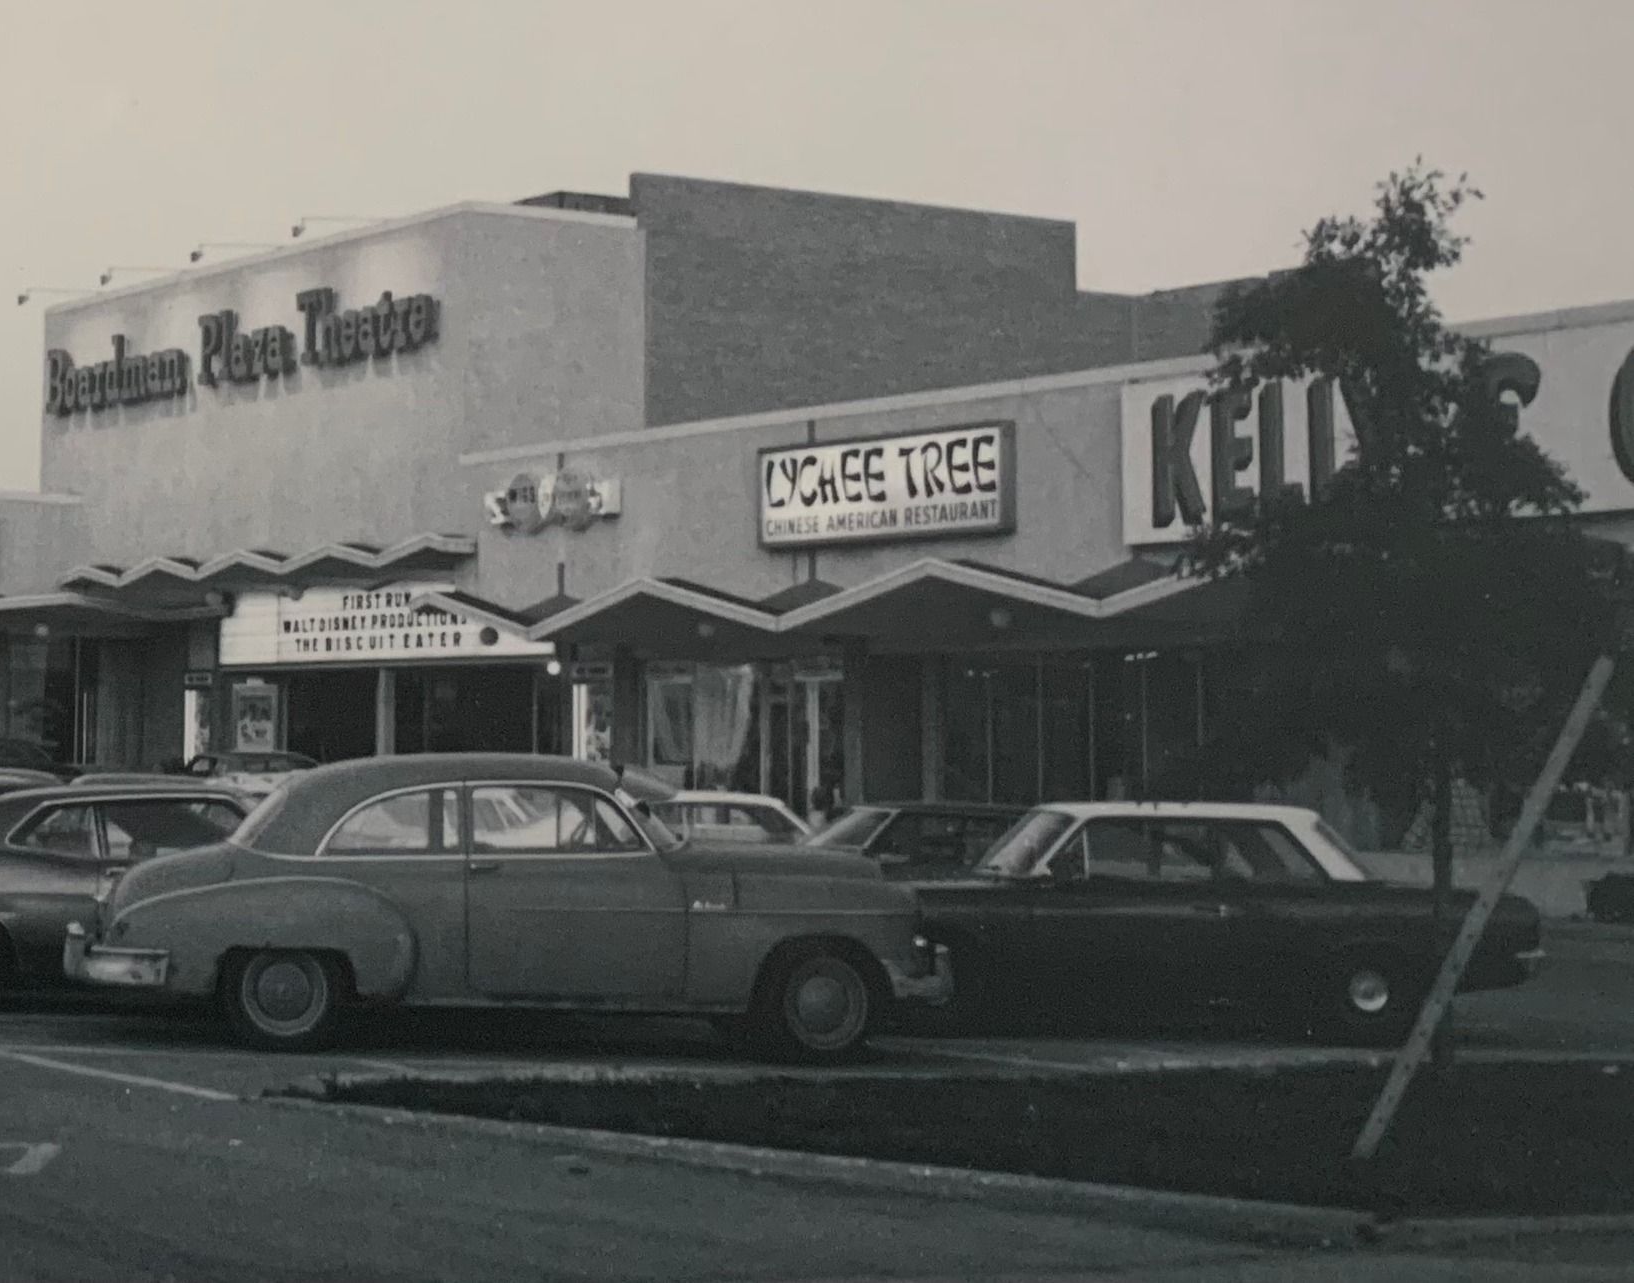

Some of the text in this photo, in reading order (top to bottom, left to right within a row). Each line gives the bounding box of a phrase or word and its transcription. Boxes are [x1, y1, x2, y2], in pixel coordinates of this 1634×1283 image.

[46, 287, 441, 418] Boardman Plaza Theatre
[766, 435, 997, 508] LYCHEE TREE
[766, 500, 997, 537] CHINESE AMERICAN RESTAURANT
[342, 593, 381, 610] FIRST
[283, 618, 316, 633] WALT
[319, 615, 366, 632] DISNEY
[295, 631, 462, 651] THE BISCUIT EATER
